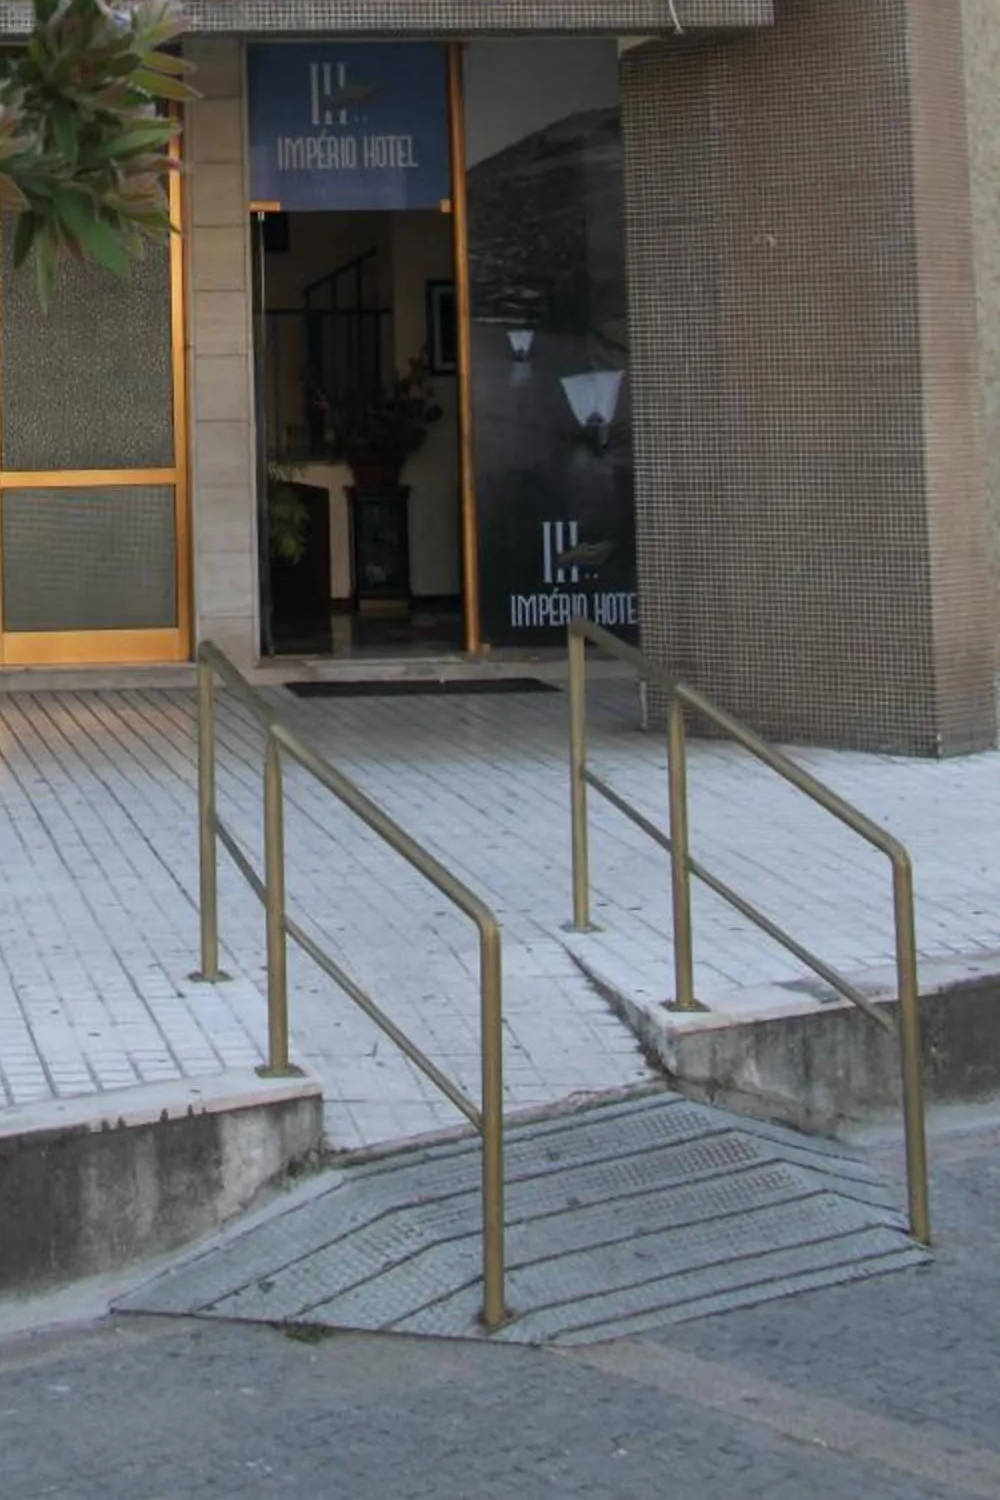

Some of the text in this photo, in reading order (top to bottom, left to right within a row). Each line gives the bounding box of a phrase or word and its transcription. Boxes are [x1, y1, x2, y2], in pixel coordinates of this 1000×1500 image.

[277, 128, 419, 171] IMPÉRIO HOTEL
[510, 587, 638, 627] IMPÉRIO HOTE
